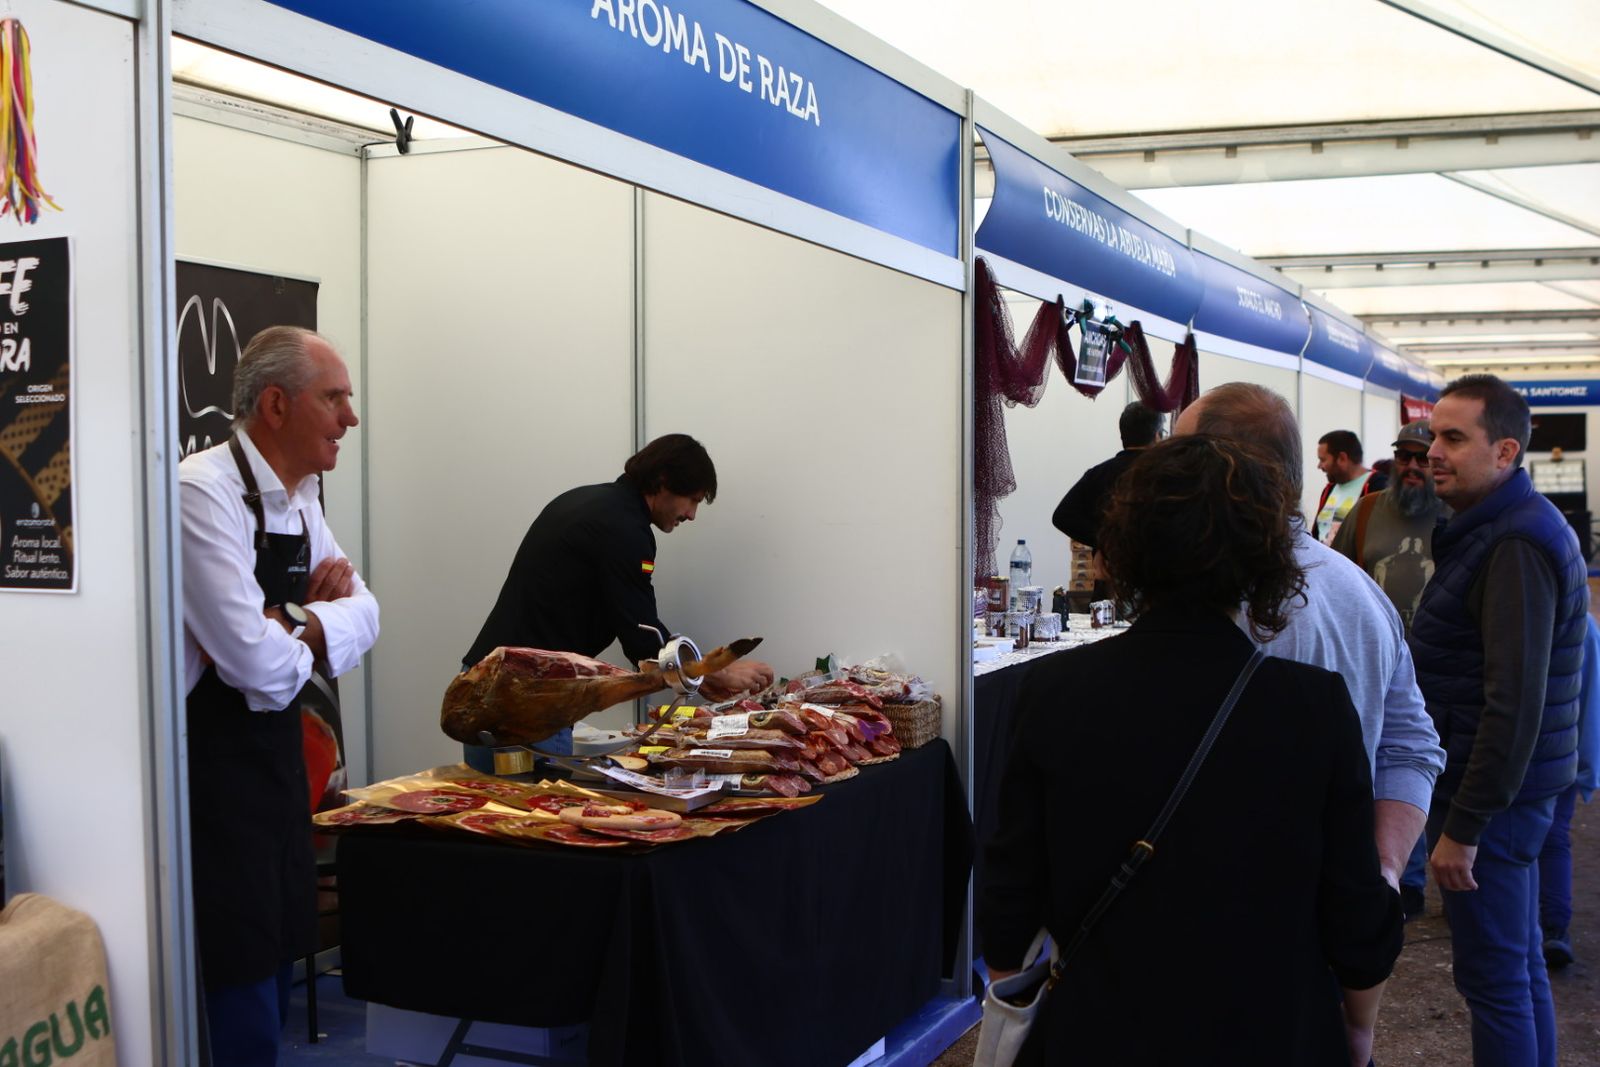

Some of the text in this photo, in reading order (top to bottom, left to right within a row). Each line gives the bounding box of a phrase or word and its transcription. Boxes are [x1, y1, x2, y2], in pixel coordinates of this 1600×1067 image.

[591, 0, 820, 126] AROMA DE RAZA
[1044, 186, 1104, 243] CONSERVAS
[1103, 219, 1119, 250] LA
[1118, 226, 1152, 267] ABUELA
[4, 322, 19, 335] EN
[27, 384, 53, 393] ORIGEN
[15, 394, 66, 404] SELECCIONADO
[11, 534, 40, 547] Aroma
[14, 550, 37, 563] Ritual
[5, 565, 29, 578] Sabor
